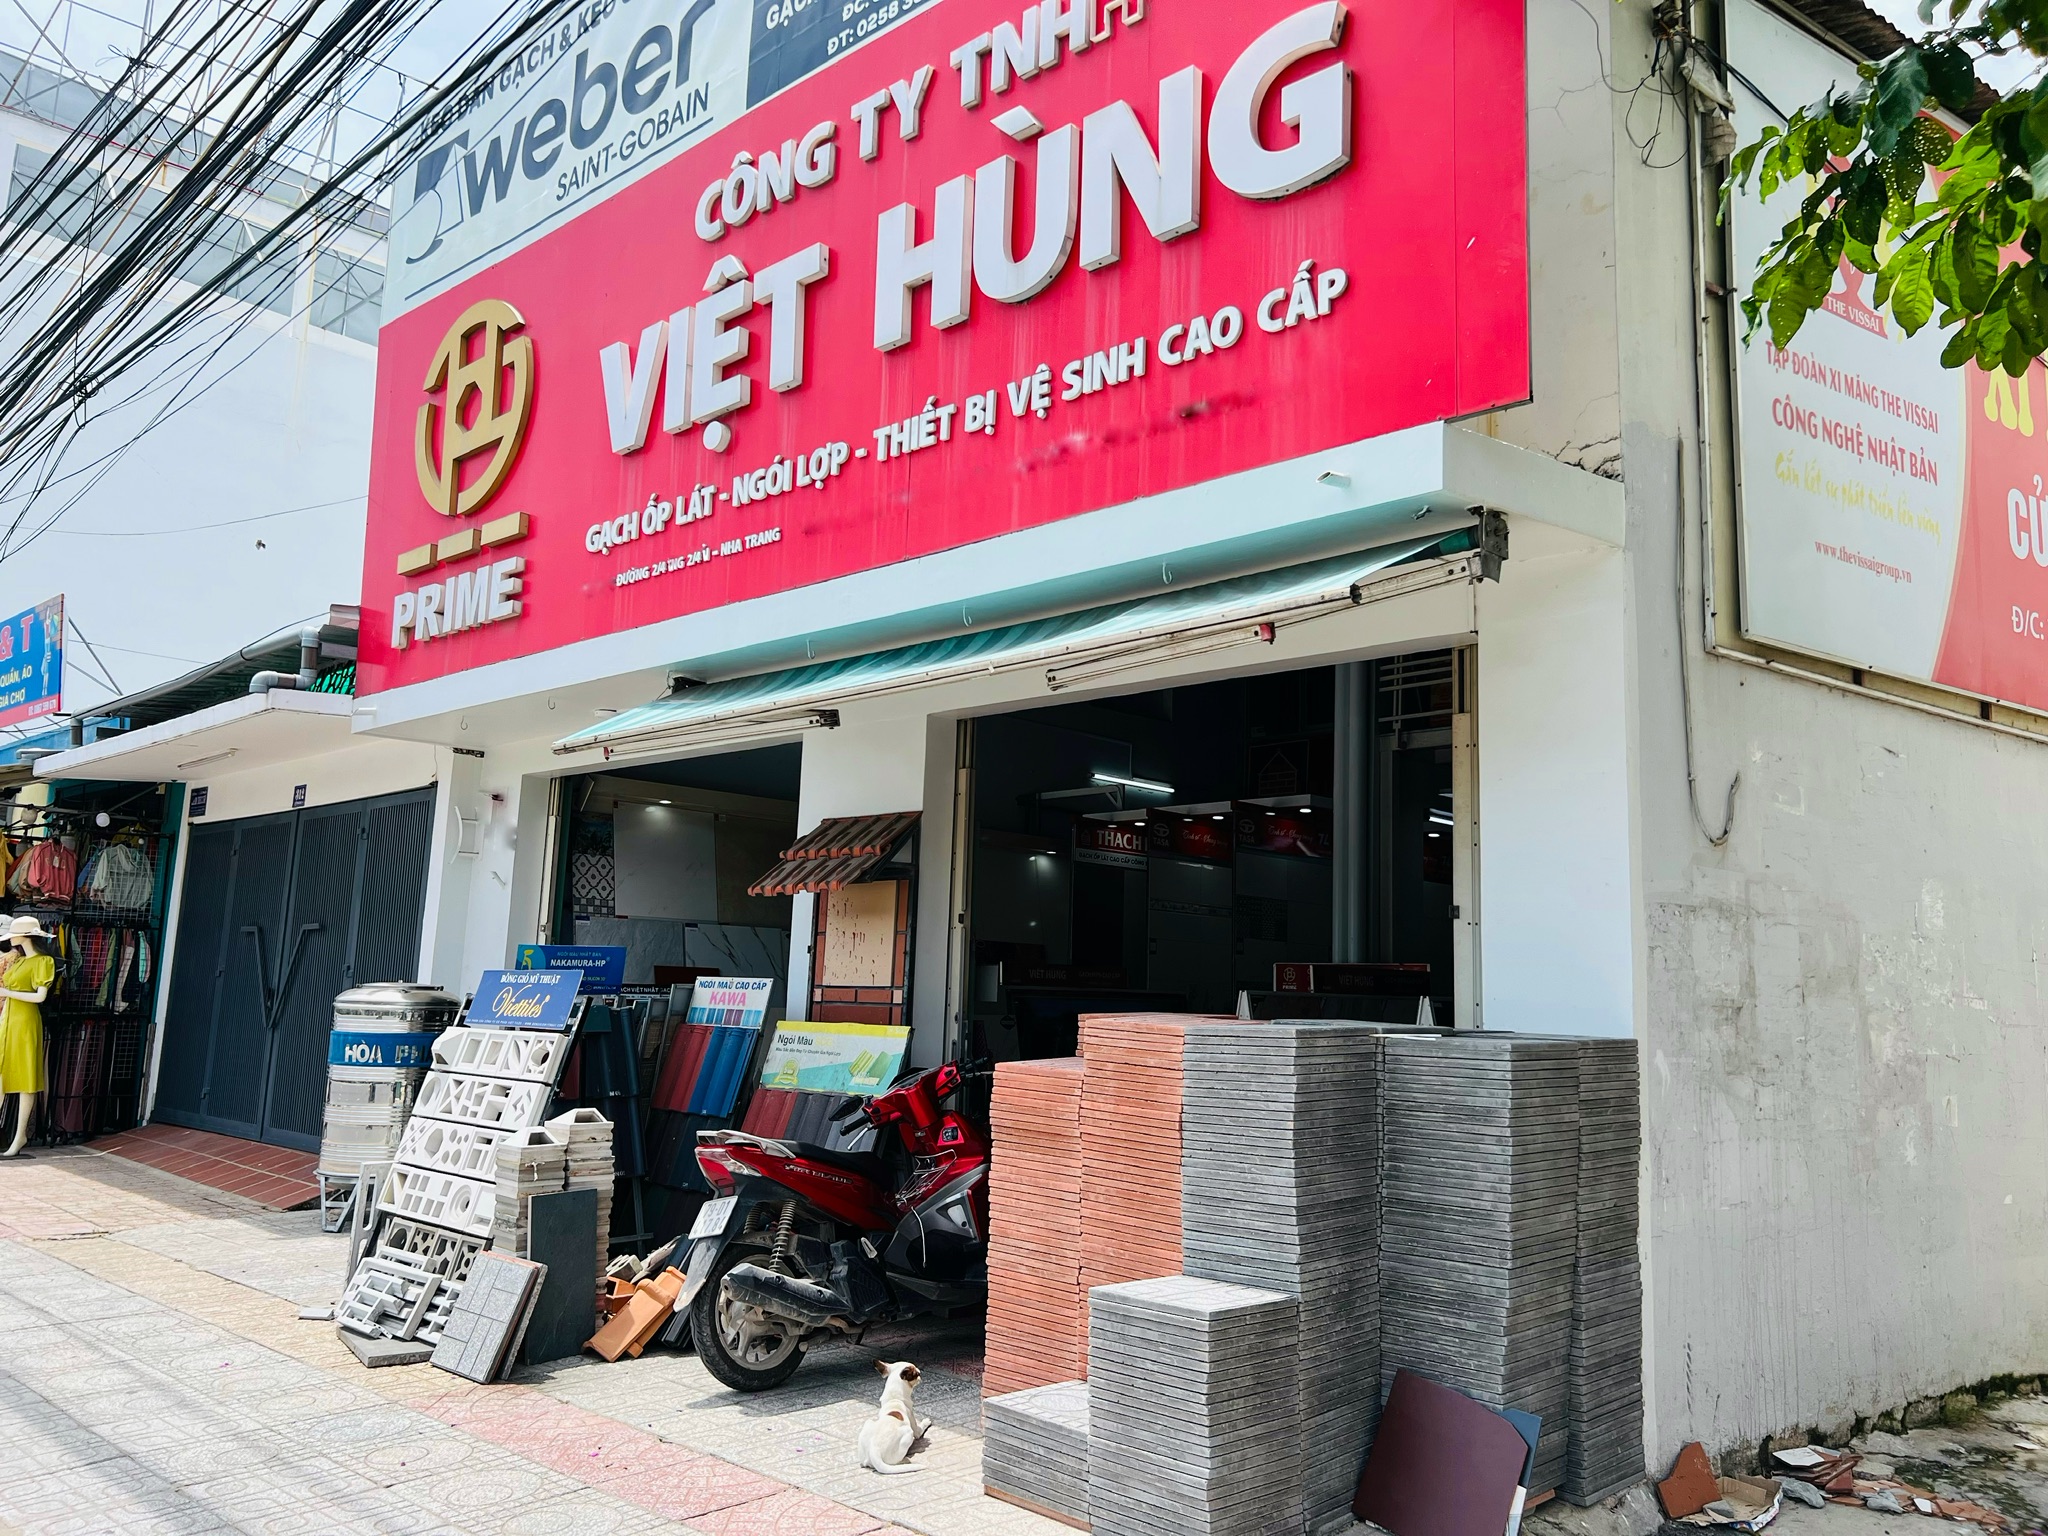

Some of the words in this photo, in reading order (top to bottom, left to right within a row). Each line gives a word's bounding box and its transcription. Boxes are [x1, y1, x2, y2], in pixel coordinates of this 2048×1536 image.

[827, 29, 855, 56] ĐT:
[856, 1, 899, 38] 0258
[464, 0, 715, 218] weber
[556, 82, 710, 201] SAINT-GOBAIN
[694, 121, 837, 242] CÔNG
[850, 64, 935, 163] TY
[599, 242, 830, 456] VIỆT
[873, 1, 1353, 351] HÙNG
[1827, 296, 1846, 317] THE
[1848, 306, 1880, 332] VISSAI
[585, 511, 640, 556] GẠCH
[641, 492, 673, 536] ỐP
[675, 482, 717, 526] LÁT
[732, 455, 794, 507] NGÓI
[796, 441, 849, 490] LỢP
[873, 396, 957, 462] THIẾT
[964, 389, 998, 436] BỊ
[1007, 362, 1052, 419] VỆ
[1062, 336, 1146, 402] SINH
[1158, 306, 1243, 367] CAO
[1257, 258, 1348, 333] CẤP
[1792, 352, 1827, 388] ĐOÀN
[1829, 367, 1841, 394] XI
[1844, 373, 1878, 409] MĂNG
[1880, 389, 1902, 419] THE
[1903, 399, 1938, 434] VISSAI
[1772, 394, 1818, 440] CÔNG
[1822, 415, 1864, 465] NGHỆ
[1867, 434, 1906, 477] NHẬT
[1909, 447, 1938, 487] BẢN
[720, 539, 743, 557] NHA
[744, 528, 782, 550] TRANG
[1814, 541, 1912, 583] www.thevissaigroup.vn
[391, 557, 526, 650] PRIME
[2011, 605, 2045, 640] Đ/C:
[21, 614, 33, 653] T
[550, 959, 606, 967] NAKAMURA-HP
[709, 991, 747, 1006] KAWA
[735, 981, 750, 990] CAO
[345, 1040, 383, 1064] HÒA
[797, 1036, 813, 1046] Màu
